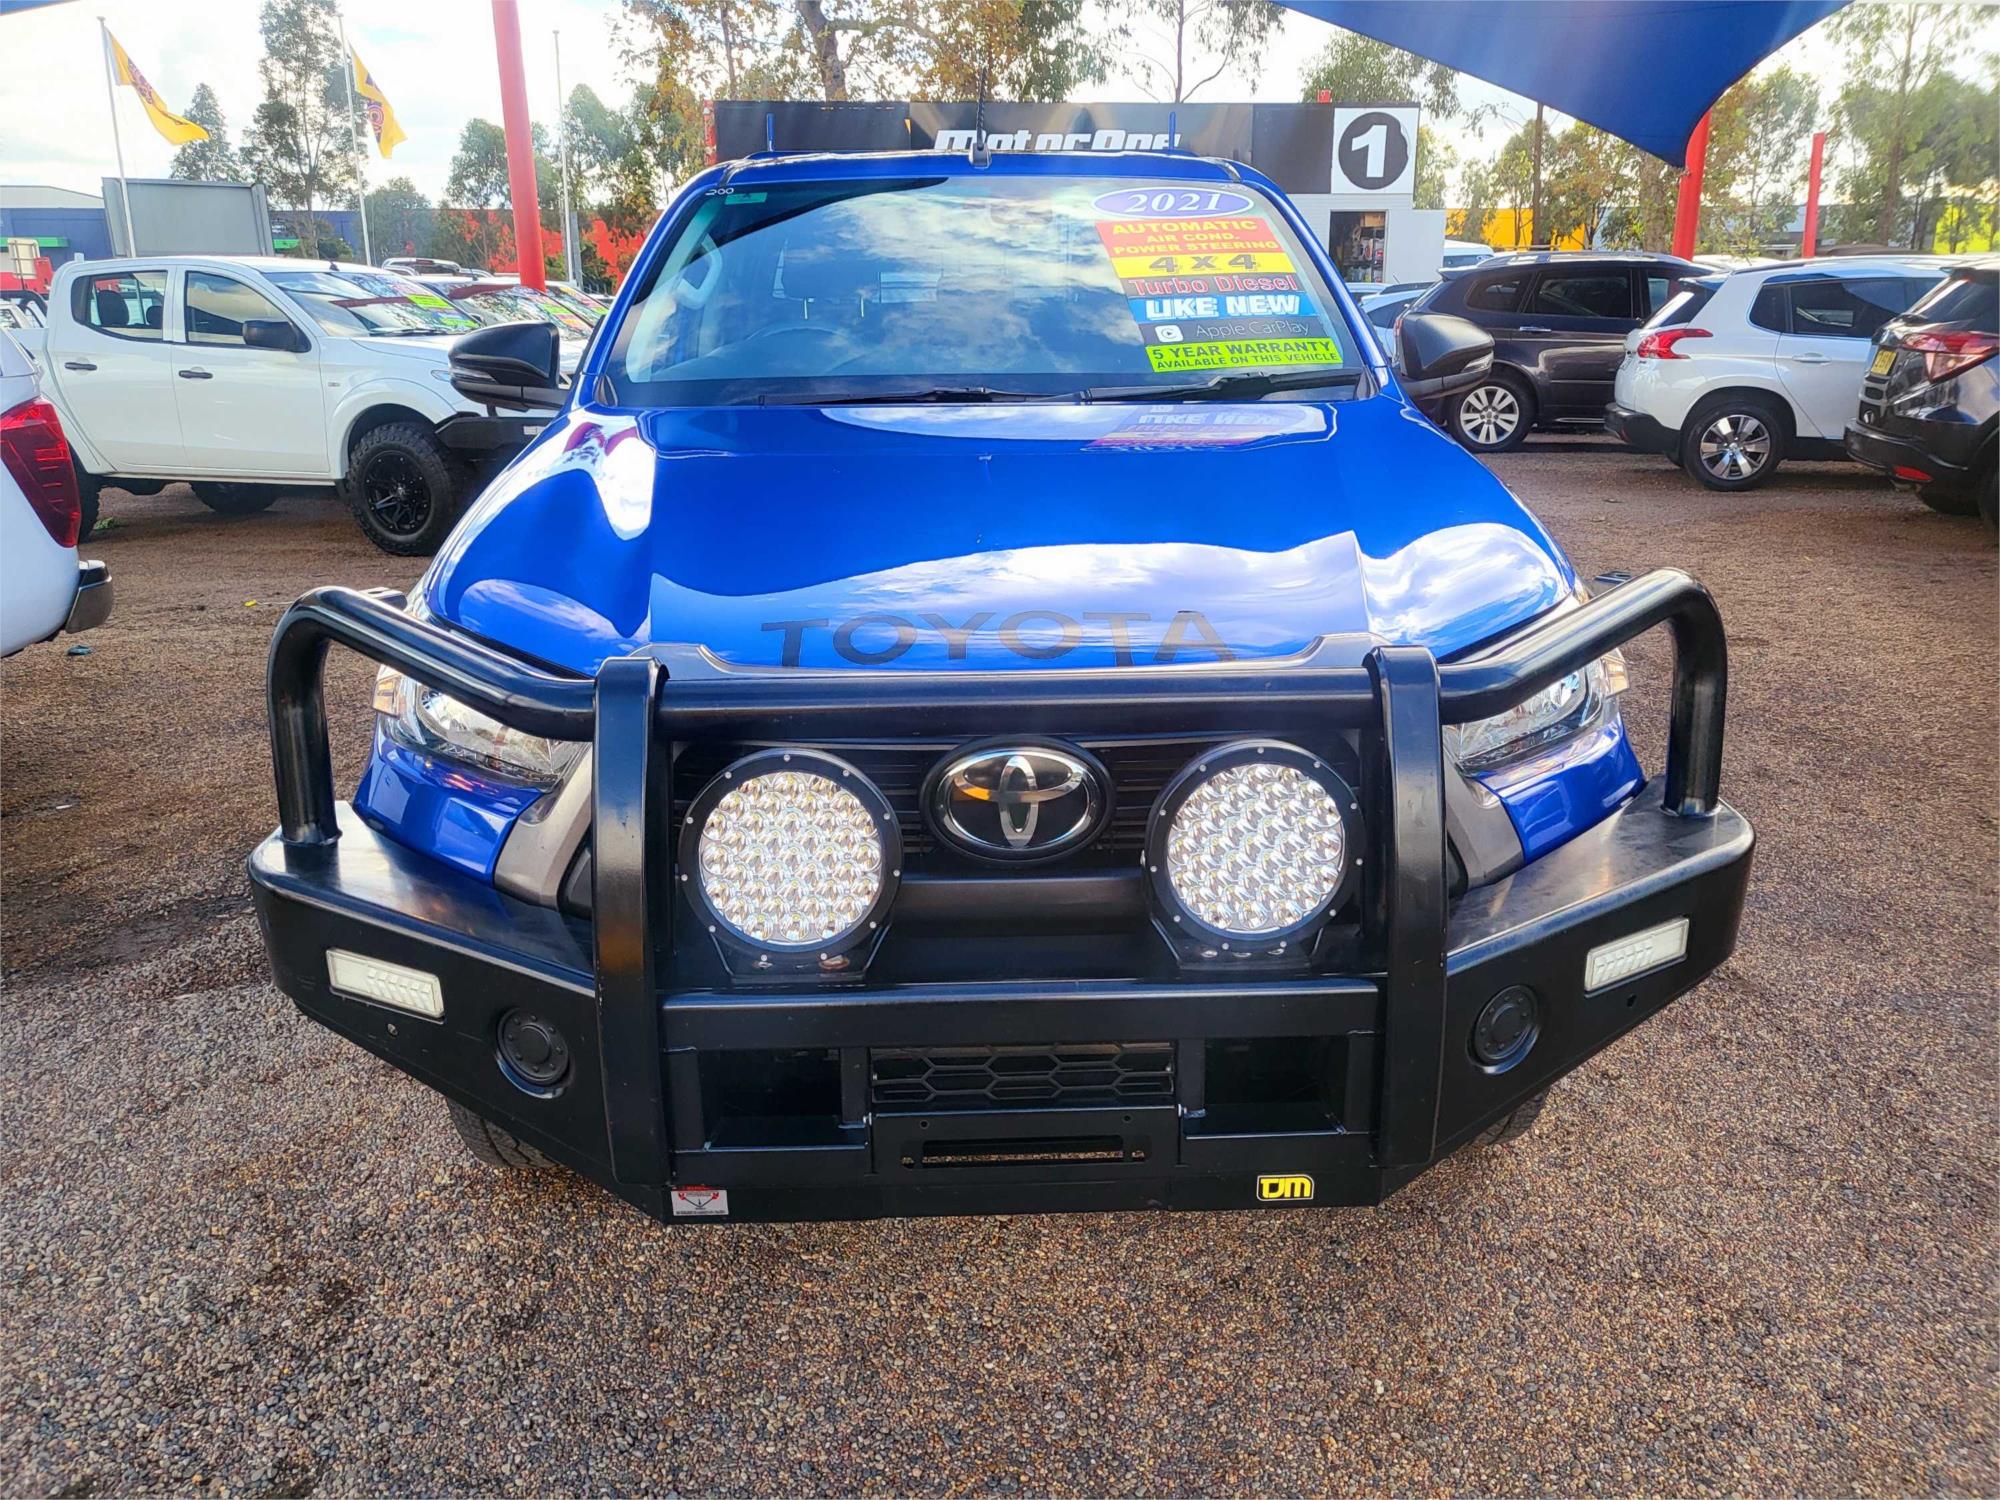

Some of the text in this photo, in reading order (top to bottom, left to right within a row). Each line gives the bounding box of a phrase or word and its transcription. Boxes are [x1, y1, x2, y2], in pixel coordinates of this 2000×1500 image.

[1352, 124, 1388, 178] 1
[1125, 193, 1222, 213] 2021
[1112, 221, 1258, 235] AUTOMATIC
[1146, 232, 1241, 243] AIR COND.
[1113, 240, 1279, 255] POWER STEERING
[1128, 275, 1299, 297] Turbo Diesel
[1145, 294, 1301, 321] LIKE NEW
[1195, 319, 1310, 339] Apple CarPlay
[1152, 340, 1331, 361] 5 YEAR WARRANTY
[1156, 352, 1338, 370] AVAILABLE ON THIS VEHICLE
[760, 610, 1238, 667] TOYOTA
